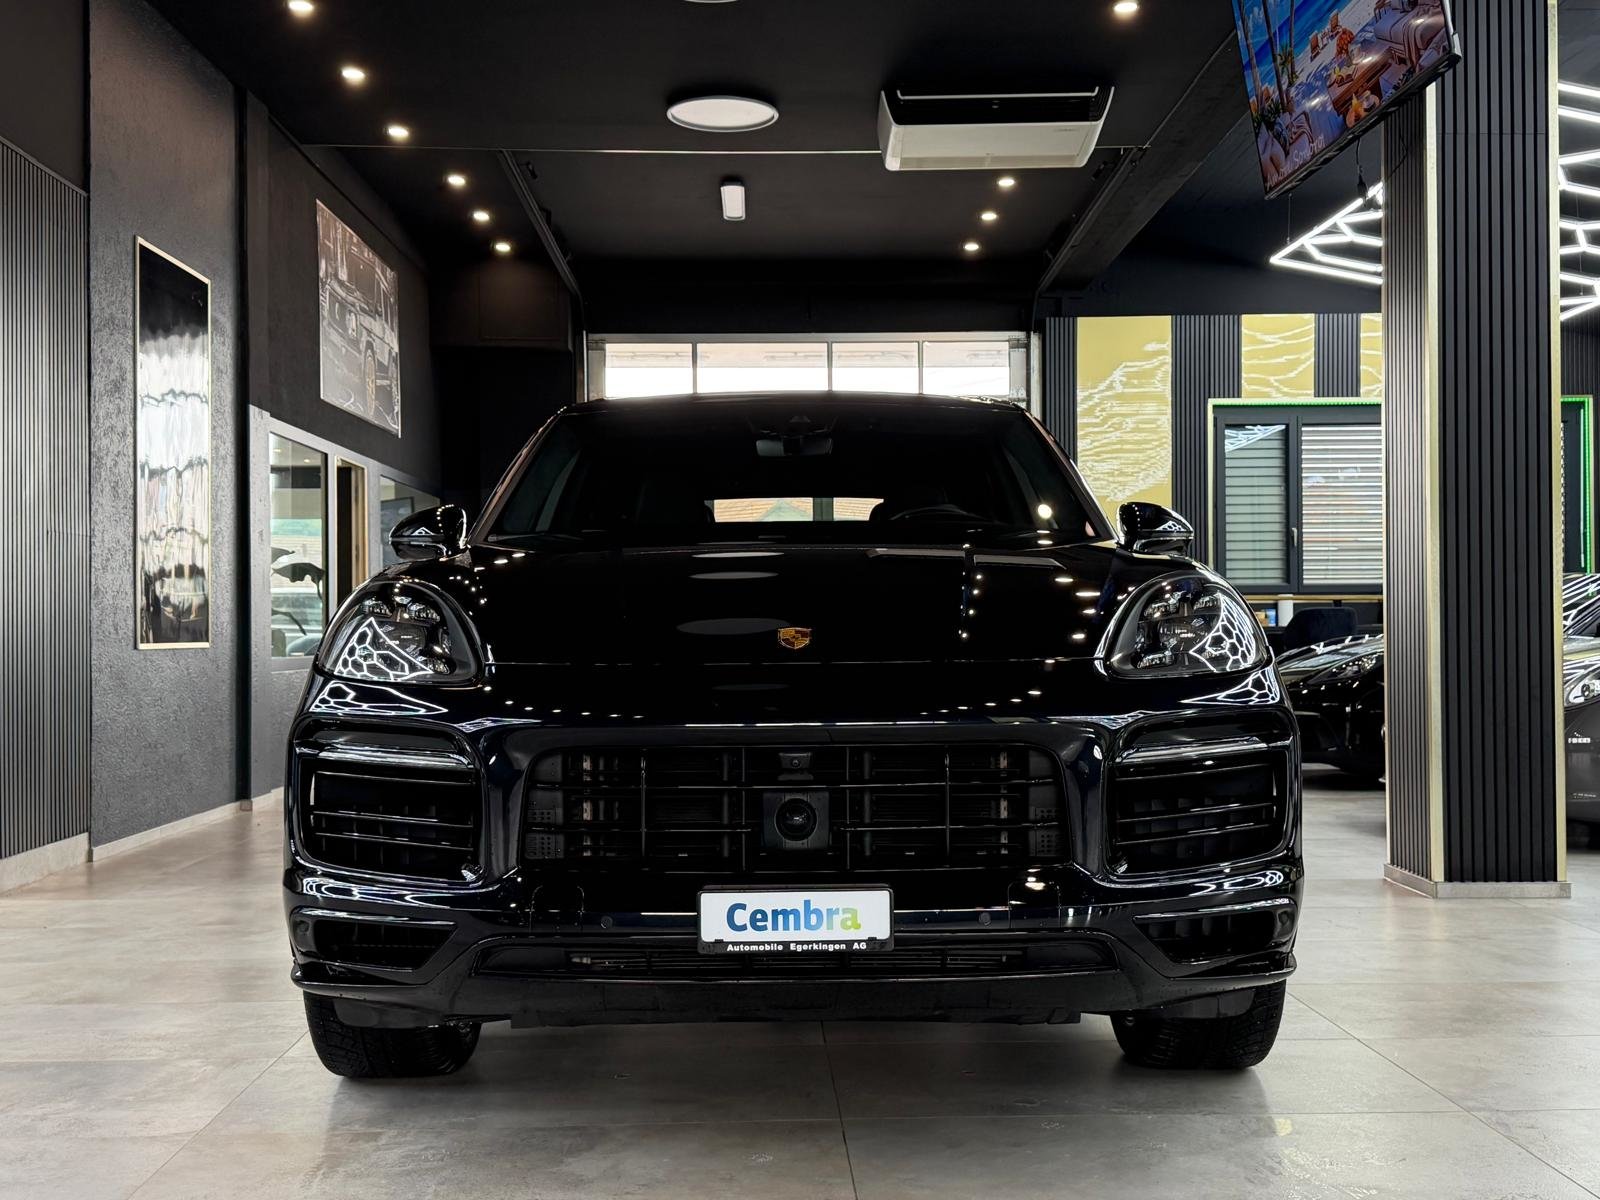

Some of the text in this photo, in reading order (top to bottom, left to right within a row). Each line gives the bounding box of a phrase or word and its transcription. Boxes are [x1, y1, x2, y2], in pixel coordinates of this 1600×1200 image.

[726, 899, 862, 932] Cembra
[726, 942, 867, 951] Automobile Egerkingen AG
